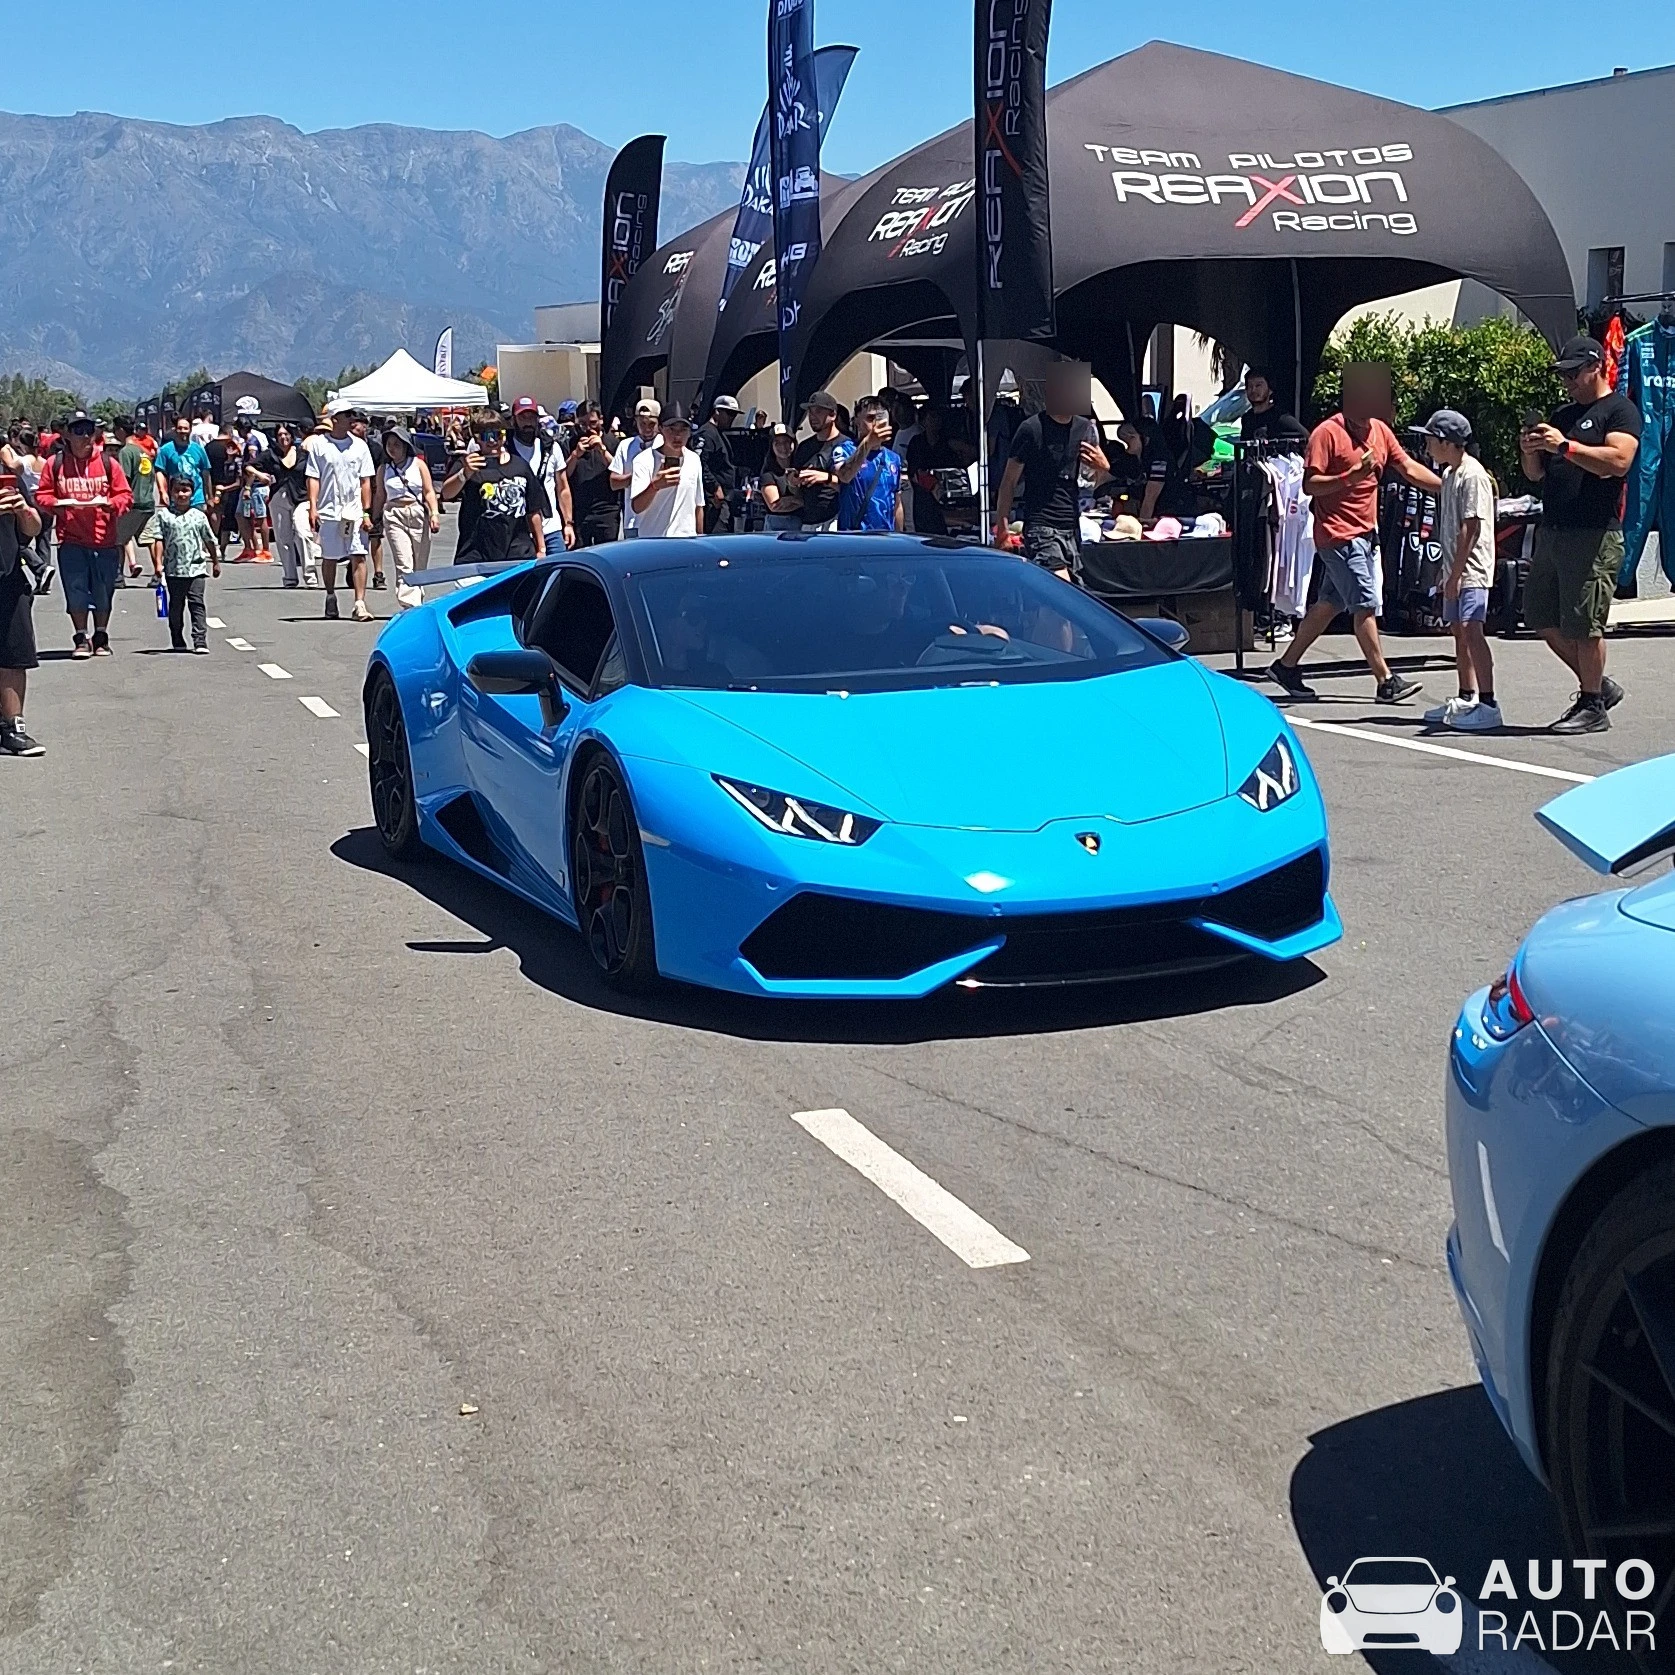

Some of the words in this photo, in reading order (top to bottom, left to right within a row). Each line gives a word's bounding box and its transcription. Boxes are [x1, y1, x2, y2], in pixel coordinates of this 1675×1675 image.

[1084, 143, 1202, 169] TEAM
[1228, 142, 1414, 169] PILOTOS
[741, 183, 774, 216] DAKA
[891, 187, 940, 205] TEAM
[1111, 171, 1409, 228] REAXION
[628, 193, 648, 276] Racing
[1272, 210, 1419, 235] Racing
[606, 191, 636, 329] AXION
[899, 233, 949, 258] Racing
